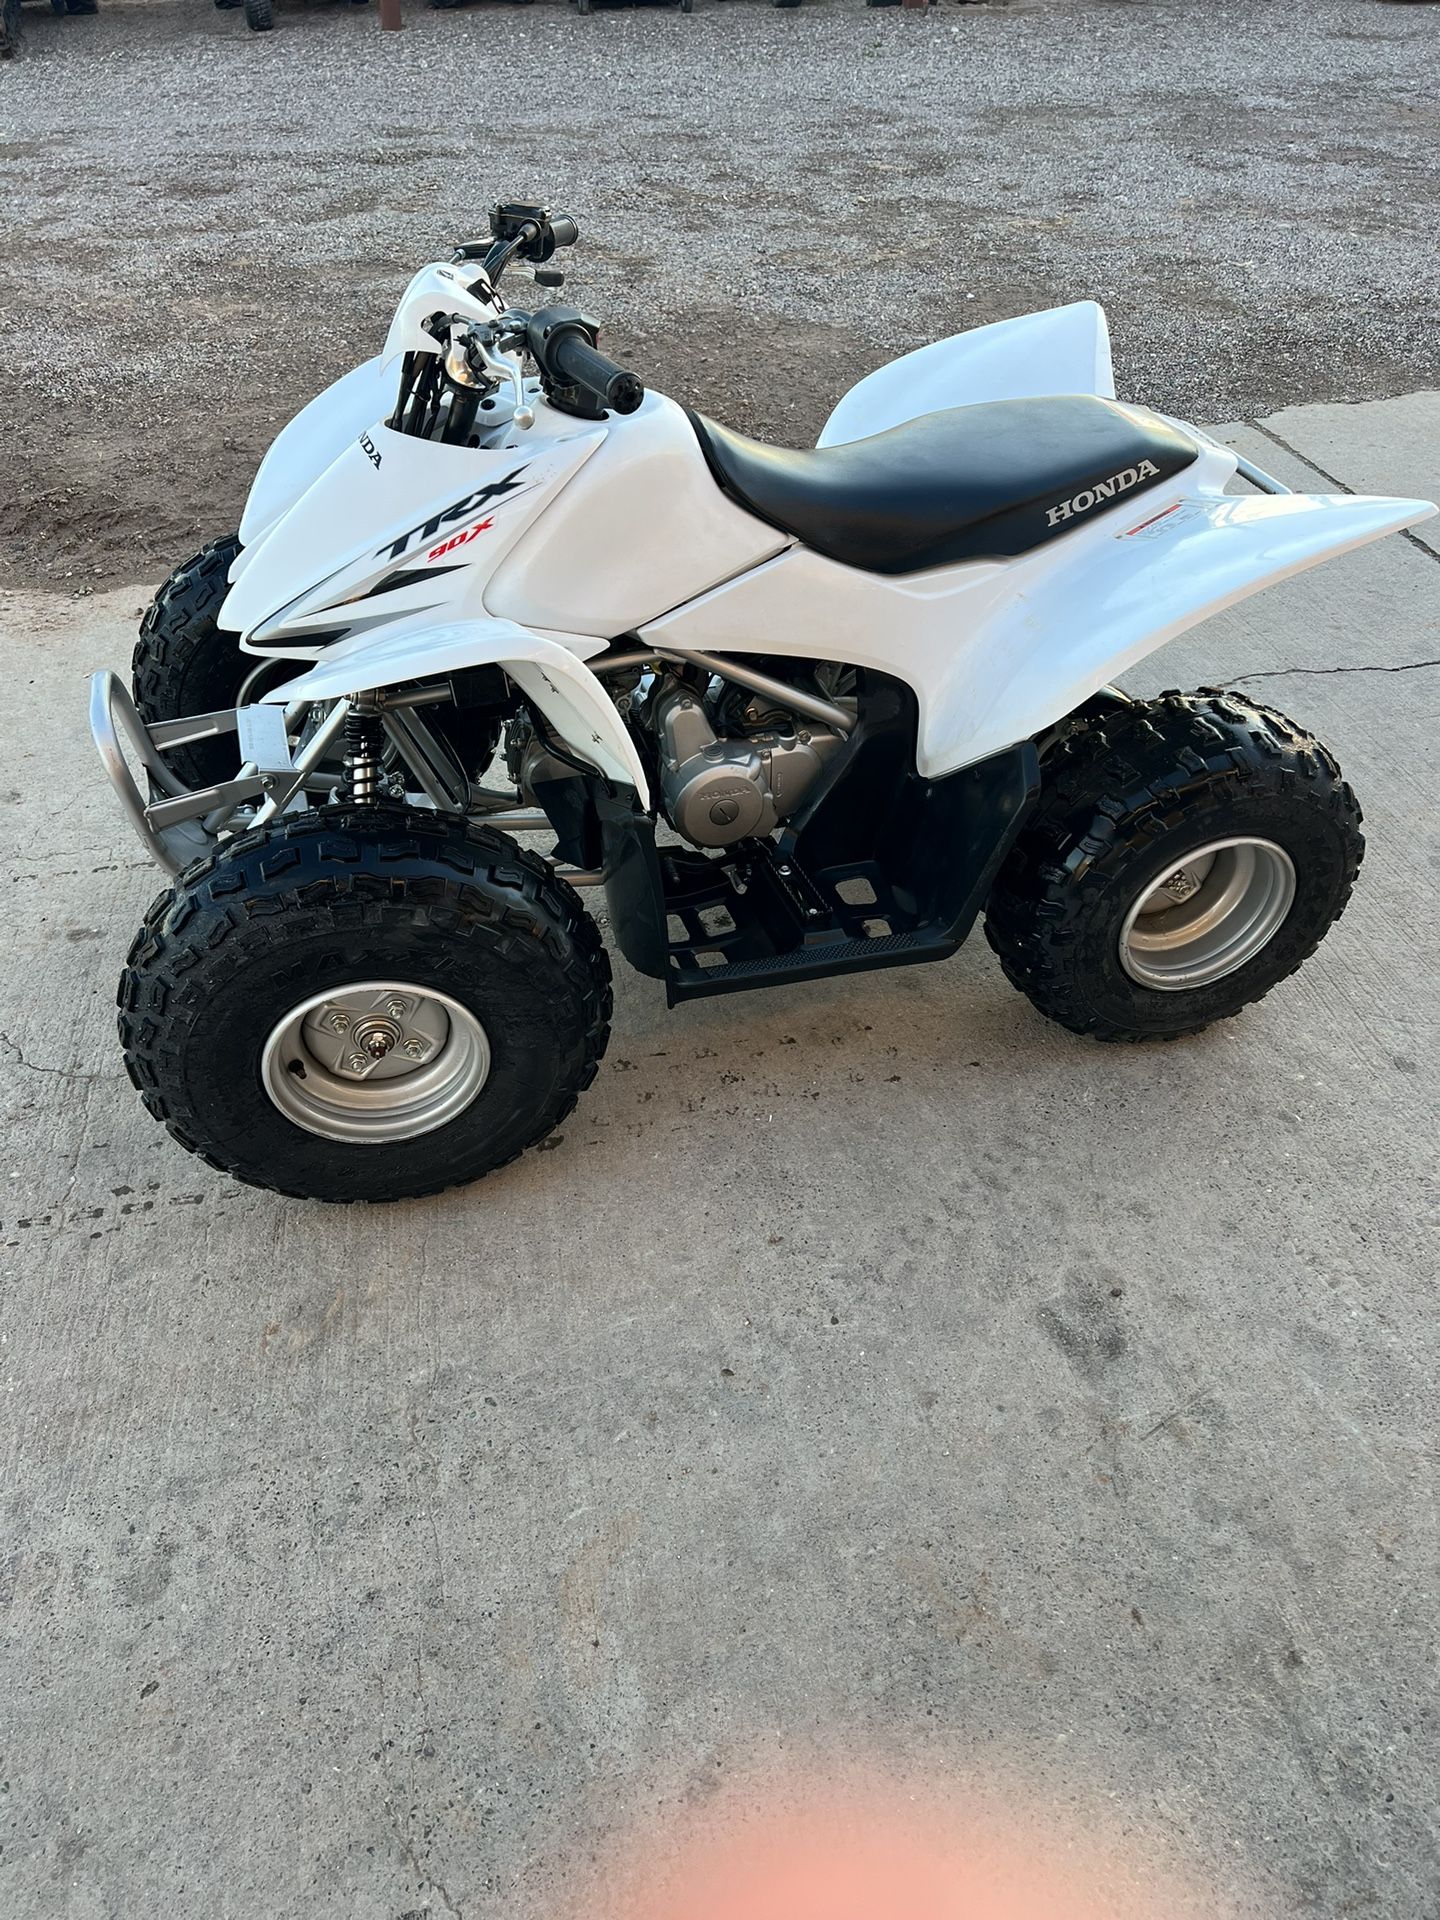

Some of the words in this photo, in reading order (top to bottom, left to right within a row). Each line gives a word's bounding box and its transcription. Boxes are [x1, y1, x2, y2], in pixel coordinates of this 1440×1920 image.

[374, 463, 531, 560] TRX
[1045, 459, 1160, 527] HONDA
[428, 516, 496, 563] 90X
